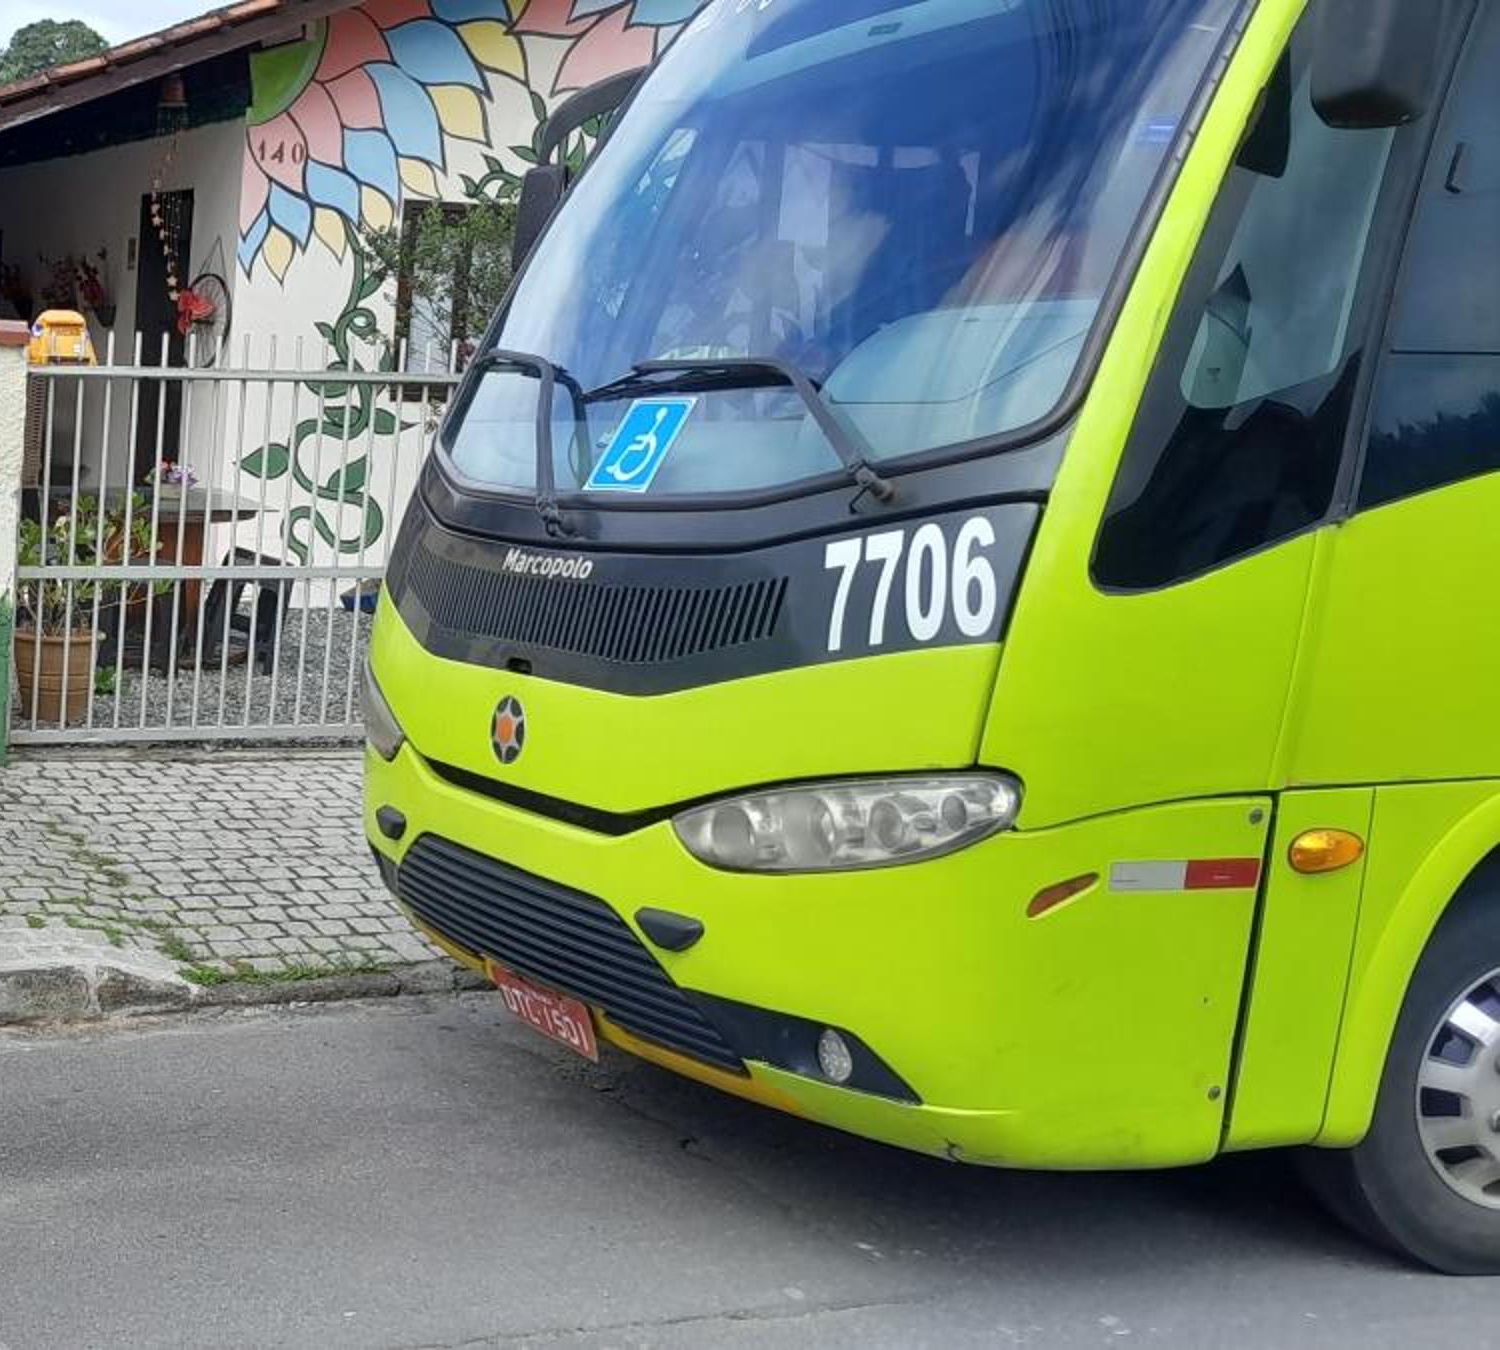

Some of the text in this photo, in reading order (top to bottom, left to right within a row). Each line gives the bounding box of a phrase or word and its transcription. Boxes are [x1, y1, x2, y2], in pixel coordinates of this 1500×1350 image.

[258, 138, 304, 164] 140
[502, 547, 593, 579] Marcopolo
[825, 516, 997, 651] 7706
